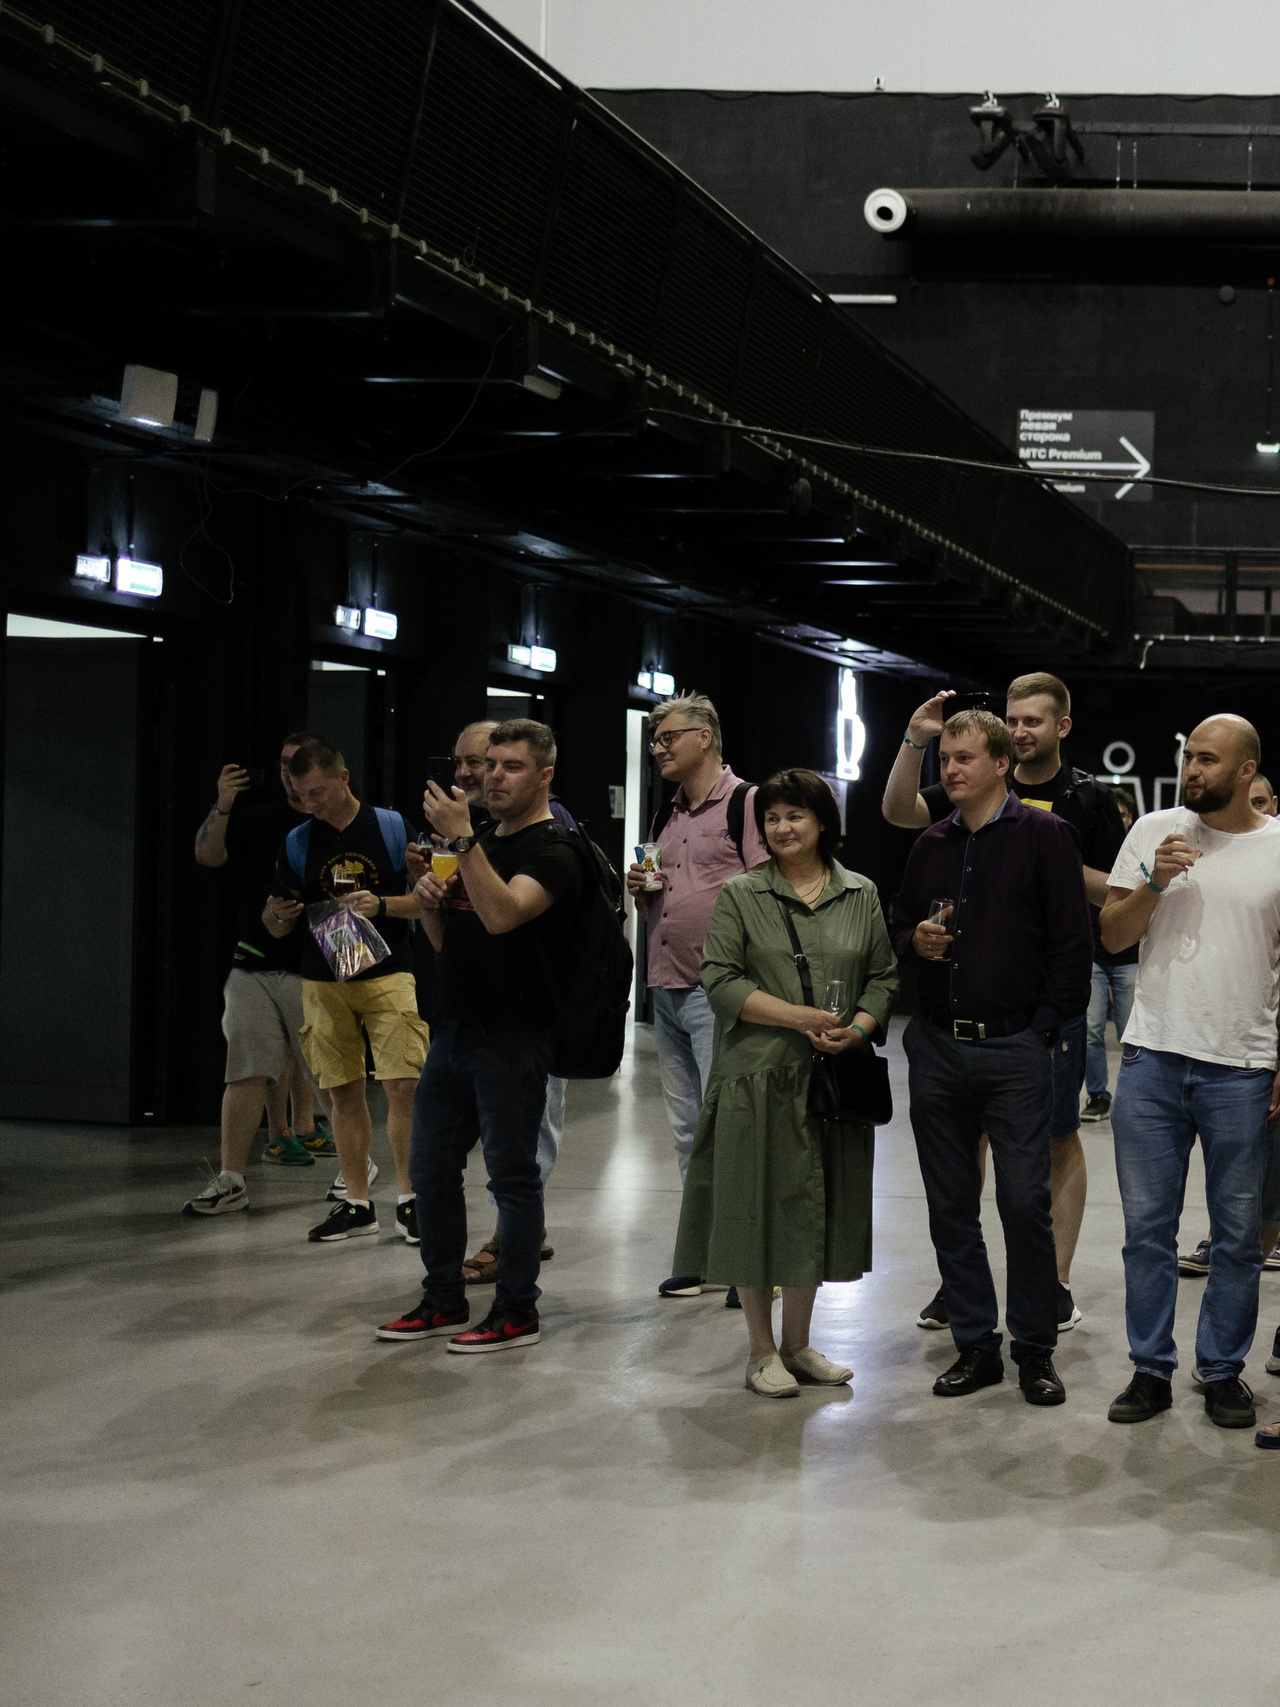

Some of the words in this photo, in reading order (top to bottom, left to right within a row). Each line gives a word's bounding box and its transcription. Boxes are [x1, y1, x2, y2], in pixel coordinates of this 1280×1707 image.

[1020, 409, 1073, 422] Премиум
[1019, 421, 1057, 431] левая
[1019, 432, 1071, 444] сторона
[1048, 447, 1103, 461] Premium
